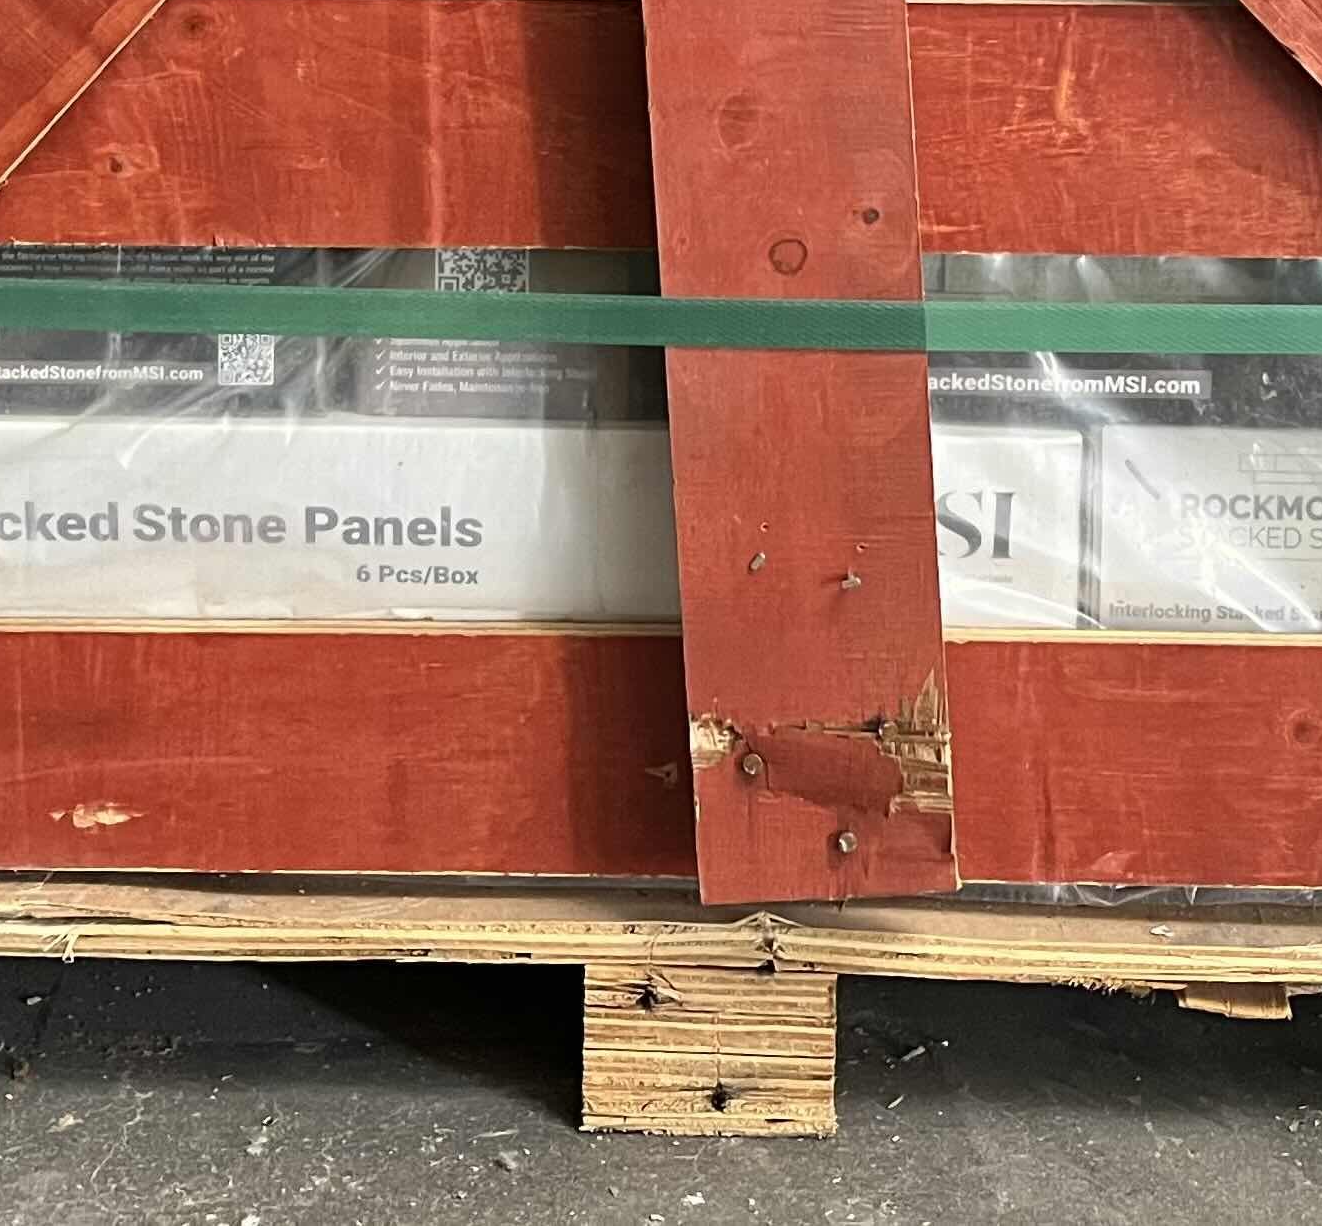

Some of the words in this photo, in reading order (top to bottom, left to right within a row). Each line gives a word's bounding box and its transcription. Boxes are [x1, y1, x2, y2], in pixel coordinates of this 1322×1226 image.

[390, 367, 414, 378] Easy
[417, 367, 473, 377] Installation
[133, 504, 286, 544] Stone
[304, 506, 483, 547] Panels
[936, 492, 1014, 559] SI
[356, 565, 371, 583] 6
[378, 565, 478, 586] Pcs/Box
[1109, 603, 1211, 623] Interlocking
